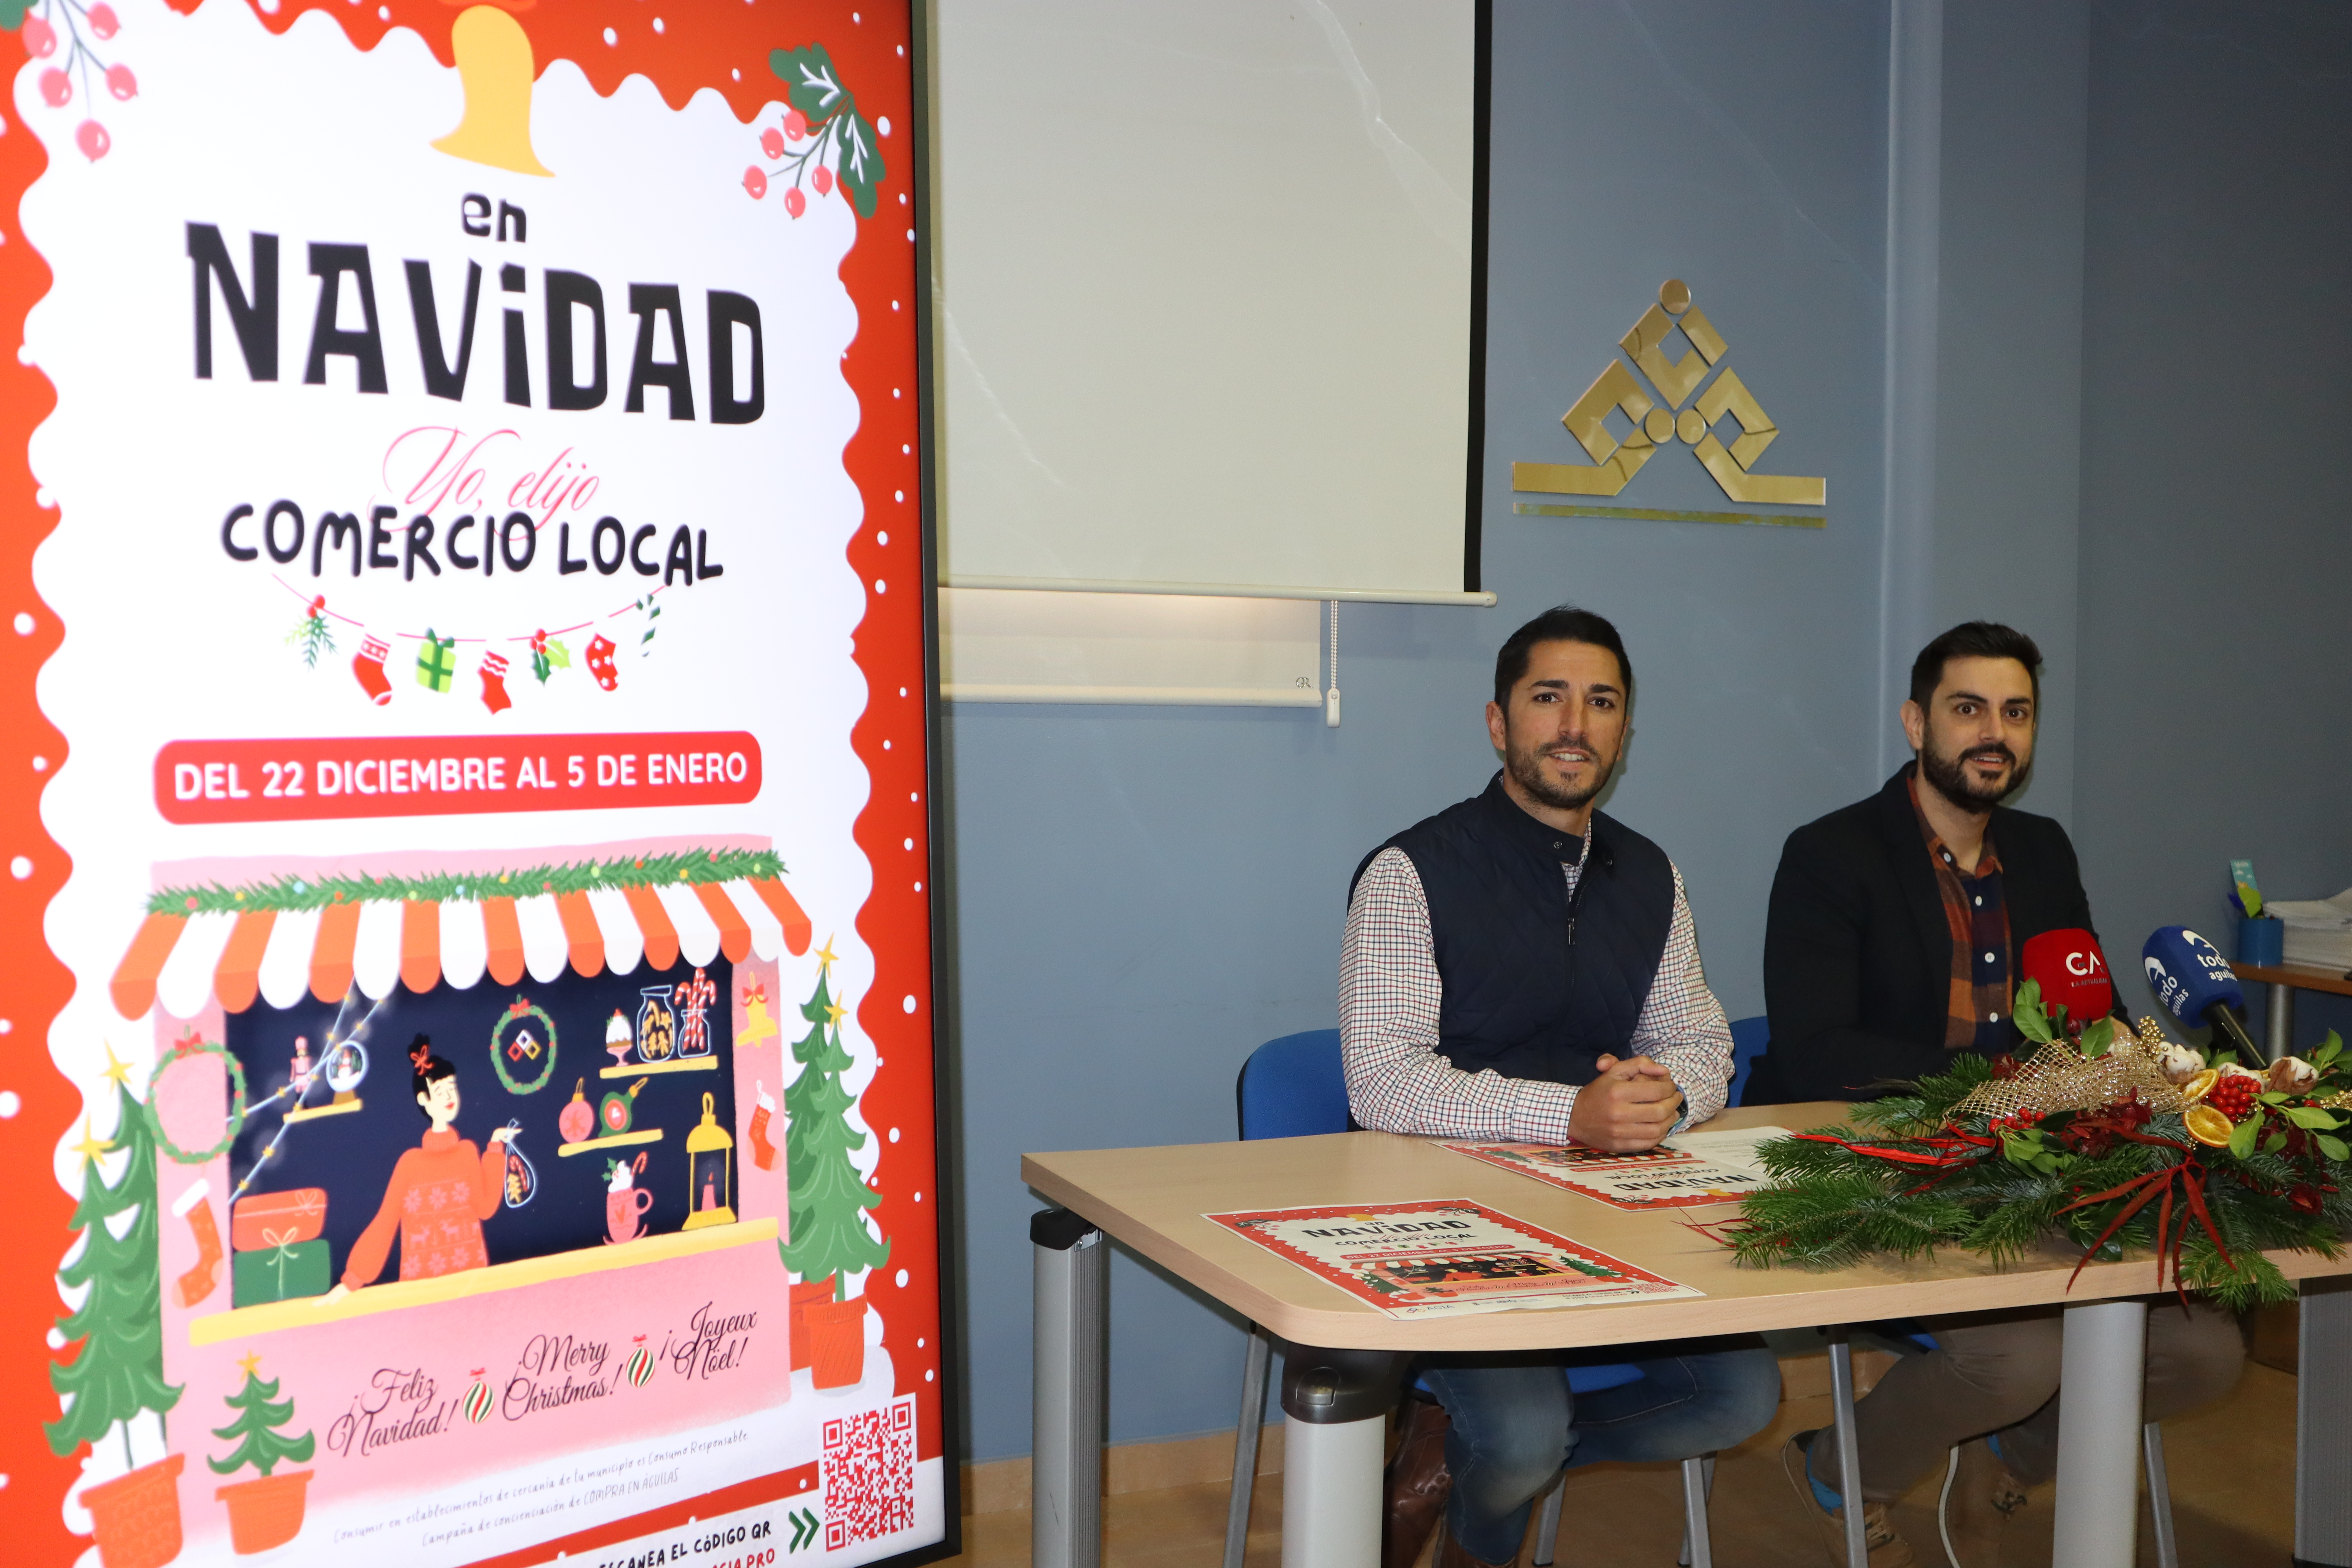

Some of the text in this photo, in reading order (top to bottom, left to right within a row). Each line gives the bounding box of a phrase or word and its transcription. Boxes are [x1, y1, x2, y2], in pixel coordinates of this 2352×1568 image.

[461, 192, 528, 243] en
[493, 447, 600, 540] elijo
[221, 499, 724, 586] COMERCIO LOCAL
[175, 751, 748, 800] DEL 22 DICIEMBRE AL 5 DE ENERO
[1335, 1237, 1420, 1246] COMERCIO
[502, 1363, 623, 1421] Christmas!
[327, 1399, 459, 1457] Navidad!
[334, 1523, 384, 1544] Consumir
[389, 1519, 401, 1530] en
[406, 1492, 493, 1523] establecimientos
[496, 1488, 509, 1502] de
[559, 1474, 571, 1486] de
[574, 1468, 584, 1483] tu
[587, 1457, 633, 1479] municipio
[637, 1456, 646, 1466] es
[648, 1446, 688, 1465] Consumo
[422, 1523, 473, 1546] Campaña
[478, 1518, 490, 1530] de
[568, 1496, 581, 1508] de
[584, 1485, 625, 1505] COMPRA
[628, 1480, 639, 1494] EN
[671, 1543, 688, 1561] EL
[751, 1520, 771, 1539] QR
